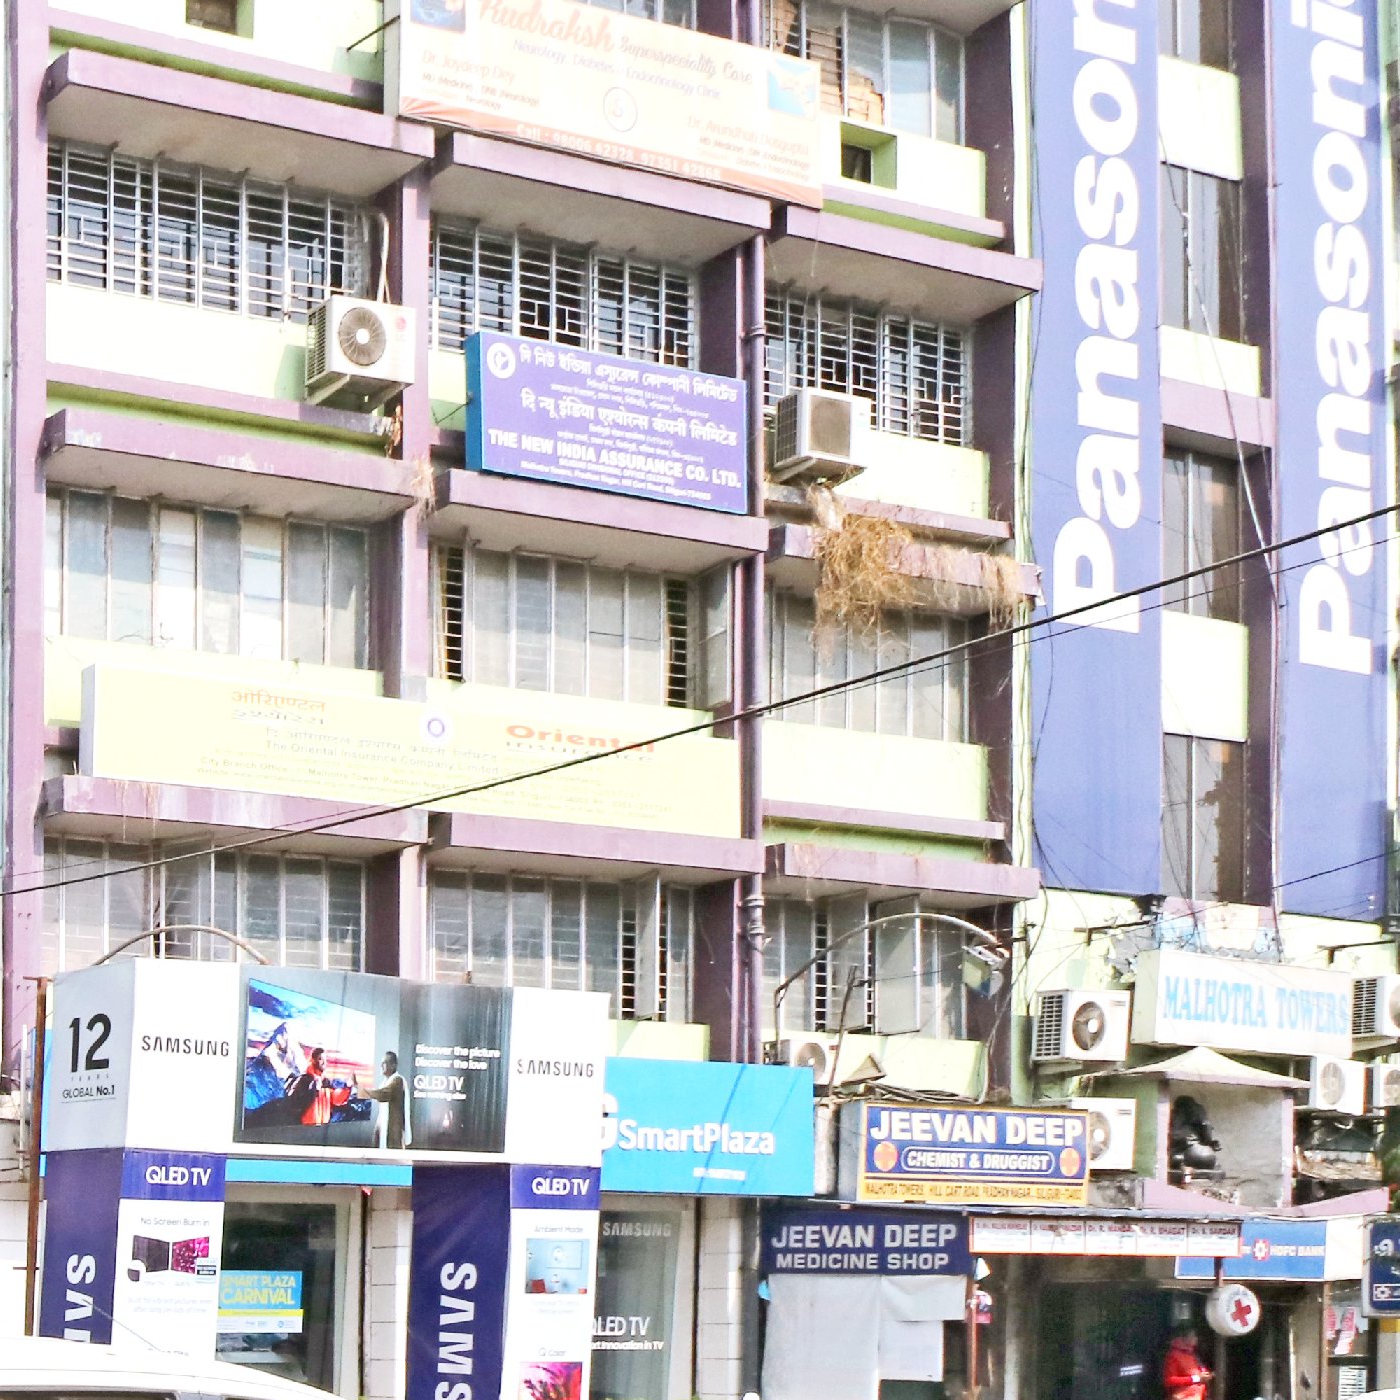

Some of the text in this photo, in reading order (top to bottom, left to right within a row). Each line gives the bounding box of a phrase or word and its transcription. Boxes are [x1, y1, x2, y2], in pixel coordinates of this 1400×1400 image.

[1290, 0, 1374, 676] Panasoni
[488, 428, 518, 449] THE
[521, 434, 554, 455] NEW
[556, 440, 597, 463] INDIA
[599, 448, 683, 478] ASSURANCE
[685, 464, 709, 482] CO.
[712, 468, 741, 488] LTD.
[266, 739, 286, 751] The
[291, 742, 337, 758] Oriental
[340, 748, 397, 763] Insurance
[401, 755, 454, 771] Company
[1162, 975, 1350, 1036] MALHOTRA TOWERS
[68, 1013, 112, 1074] 12
[140, 1034, 230, 1058] SAMSUNG
[516, 1059, 595, 1078] SAMSUNG
[62, 1084, 116, 1099] GLOBAL No.1
[413, 1074, 464, 1091] QLED TV
[617, 1118, 775, 1155] SmartPlaza
[869, 1110, 1083, 1147] JEEVAN DEEP
[907, 1150, 1050, 1171] CHEMIST & DRUGGIST
[145, 1165, 212, 1187] QLED TV
[532, 1177, 590, 1196] QLED TV
[602, 1222, 673, 1238] SAMSUNG
[771, 1224, 875, 1249] JEEVAN
[884, 1224, 957, 1248] DEEP
[775, 1253, 950, 1270] MEDICINE SHOP
[221, 1286, 296, 1306] CARNIVAL
[629, 1315, 651, 1337] TV
